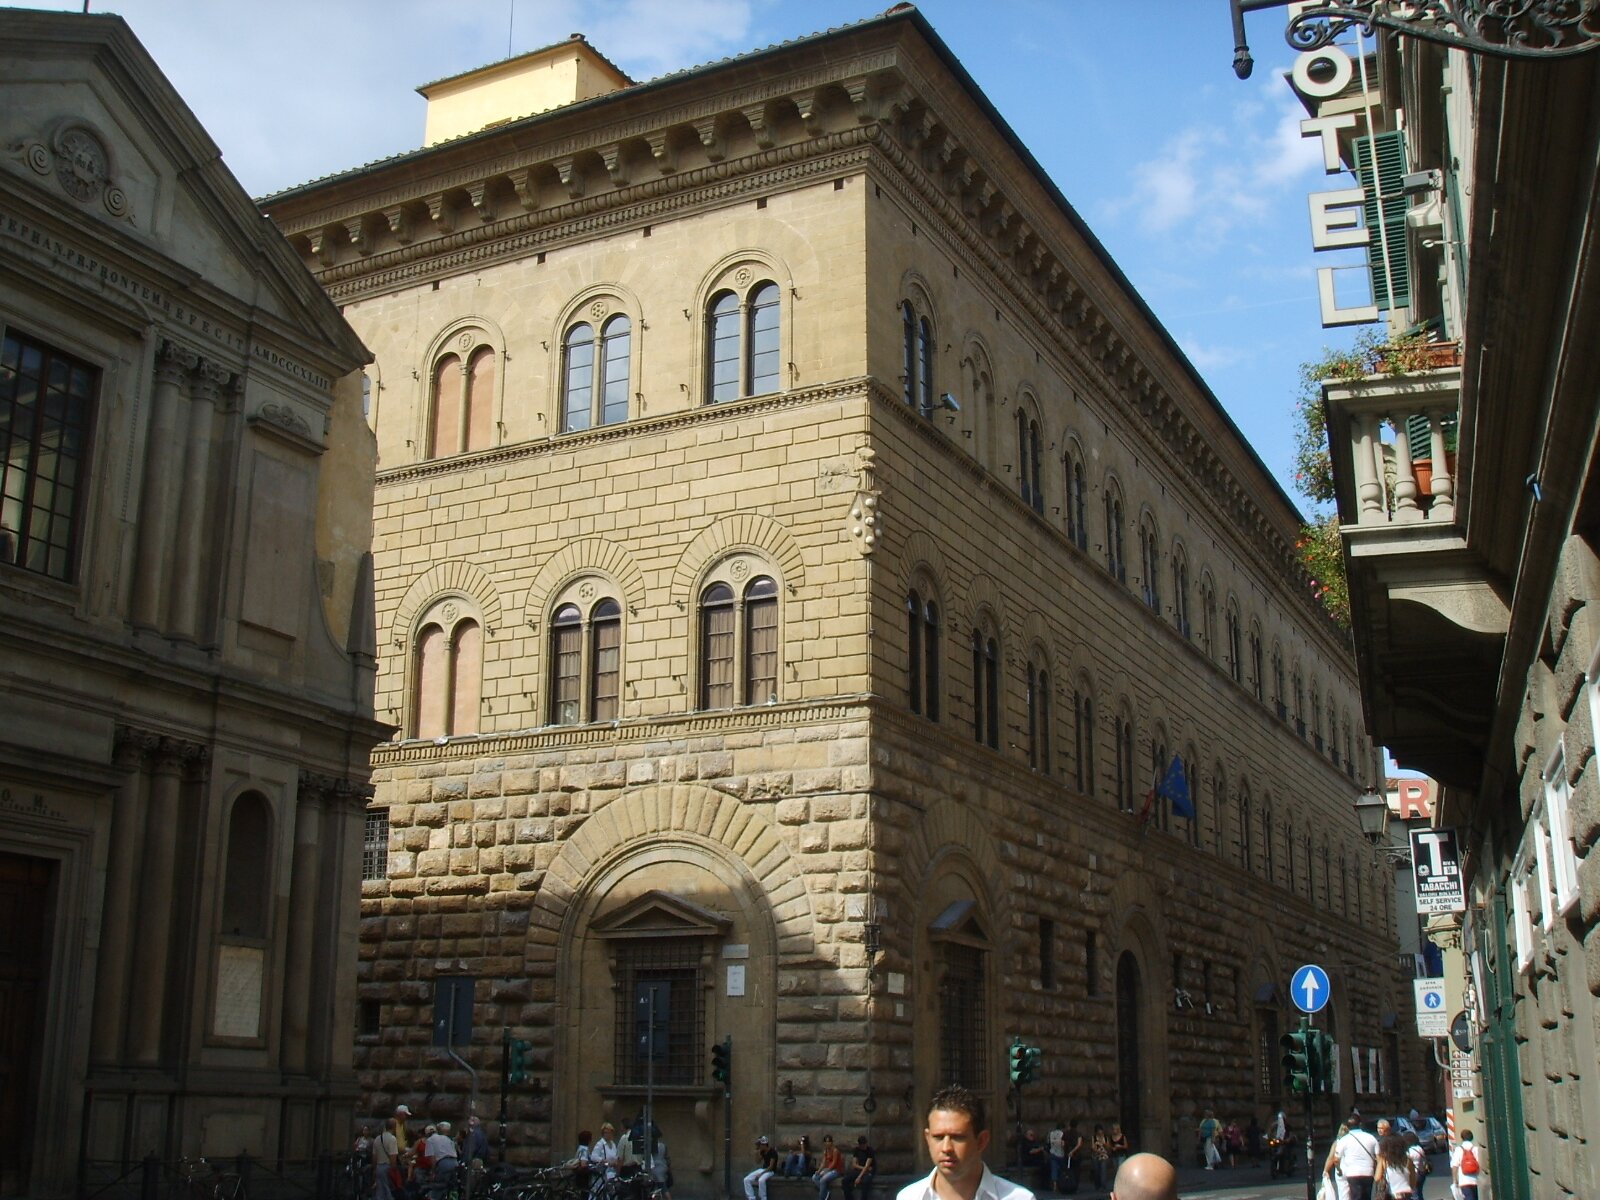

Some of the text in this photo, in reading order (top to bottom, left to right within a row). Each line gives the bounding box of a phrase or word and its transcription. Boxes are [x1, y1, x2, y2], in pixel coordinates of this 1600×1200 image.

[1398, 779, 1431, 819] R
[1418, 833, 1449, 876] T
[1420, 881, 1458, 892] TABACCHI
